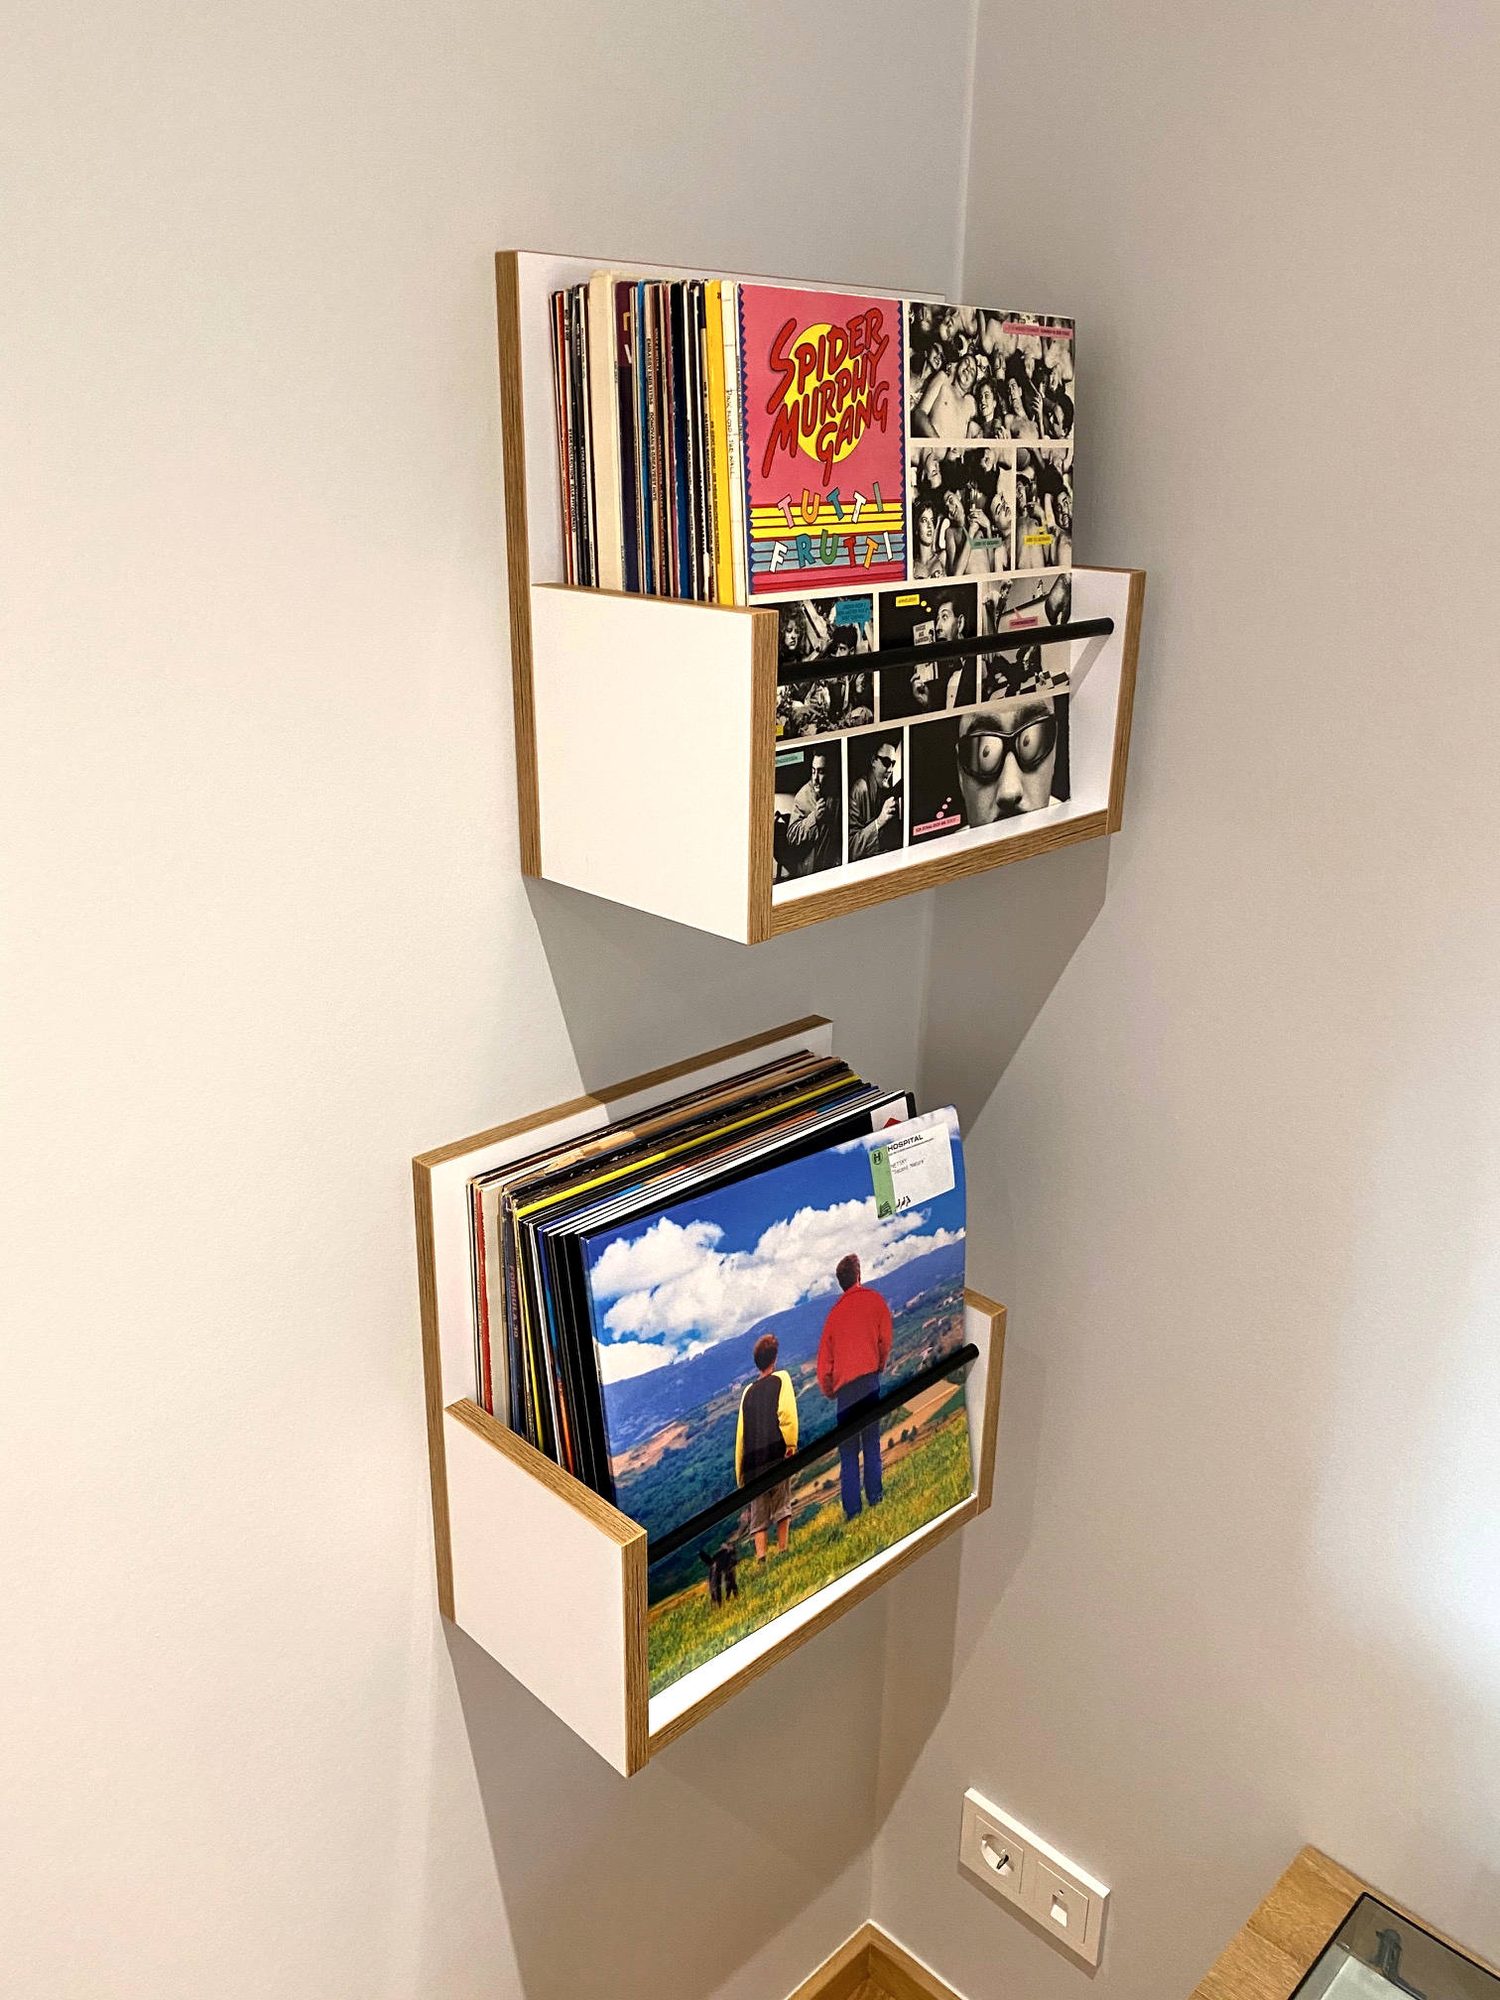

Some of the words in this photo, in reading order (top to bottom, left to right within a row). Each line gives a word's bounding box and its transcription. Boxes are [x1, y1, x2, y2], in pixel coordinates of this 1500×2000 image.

[767, 307, 884, 415] SPIDER
[762, 334, 890, 479] MURPHY
[816, 381, 890, 487] GANG
[777, 481, 884, 529] TUTTI
[769, 529, 894, 574] FRUTTI
[873, 1152, 881, 1164] H
[887, 1135, 924, 1152] HOSPITAL
[509, 1265, 518, 1320] FORMULA
